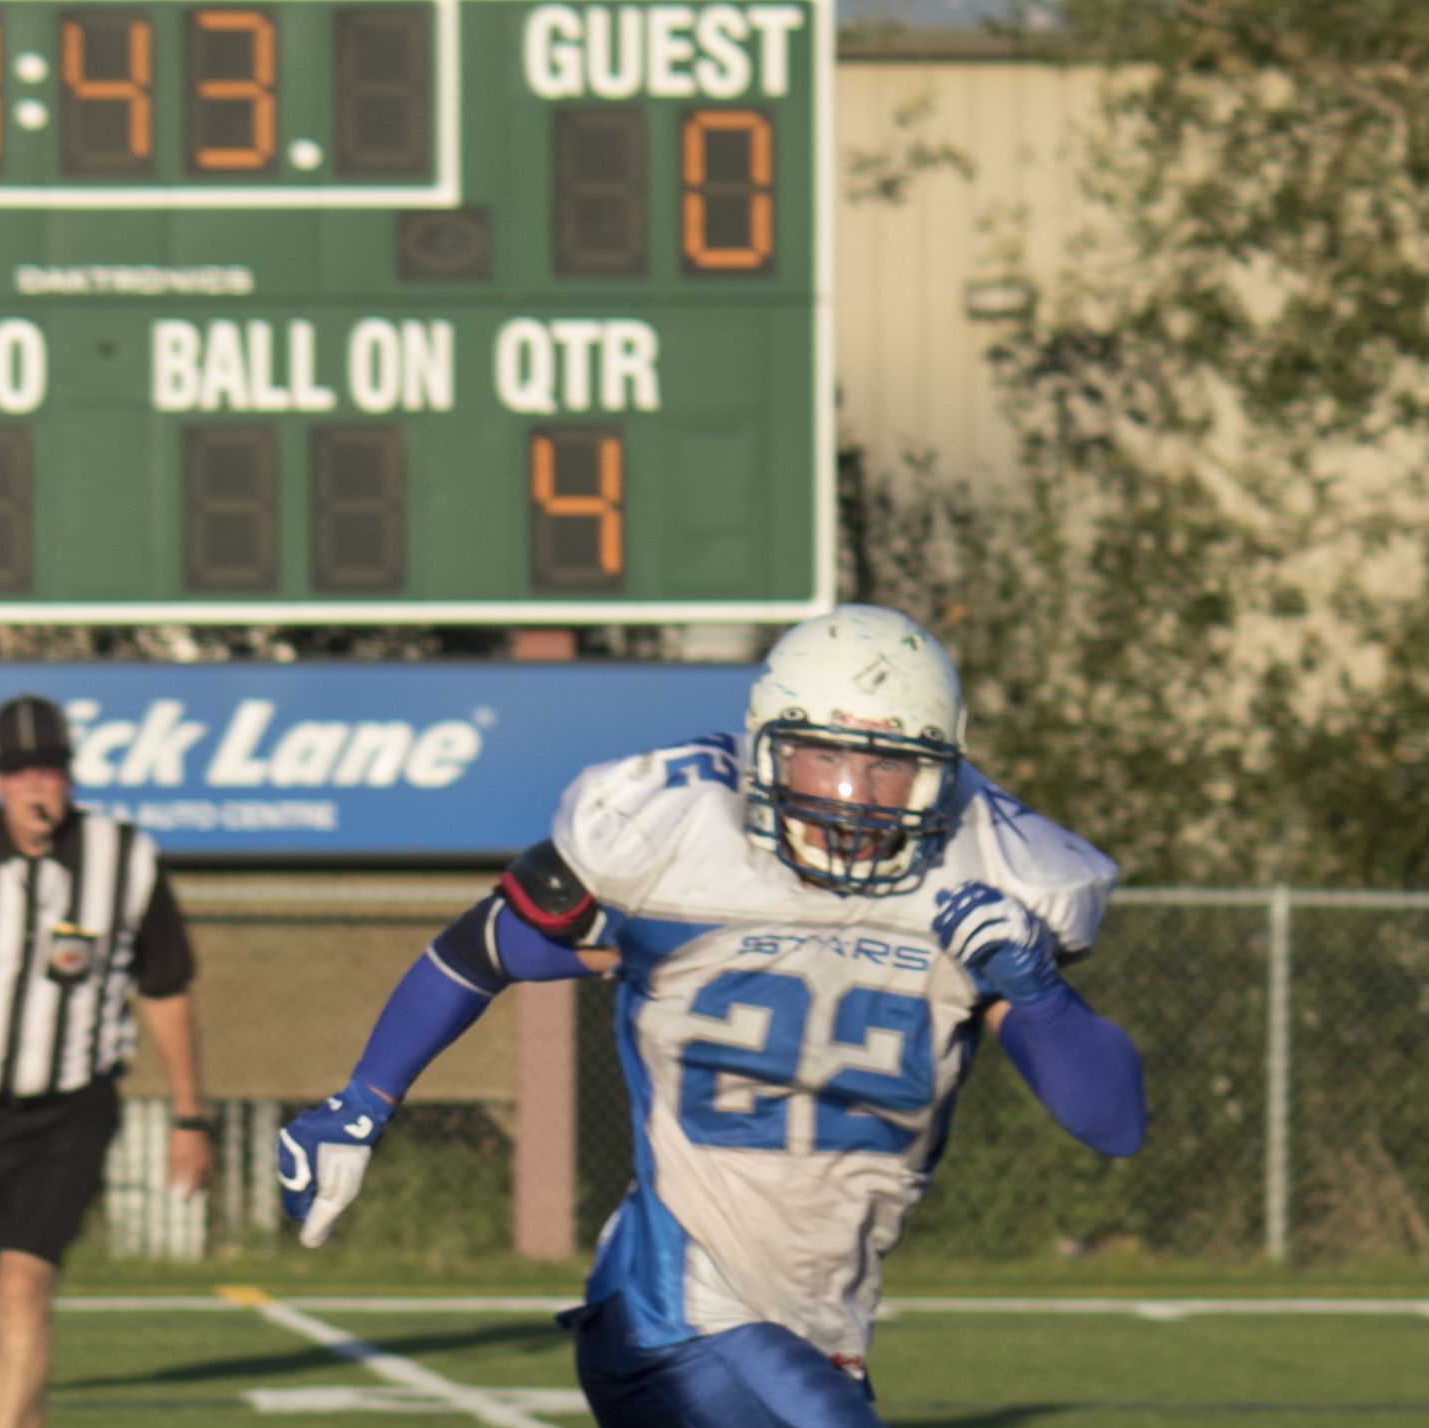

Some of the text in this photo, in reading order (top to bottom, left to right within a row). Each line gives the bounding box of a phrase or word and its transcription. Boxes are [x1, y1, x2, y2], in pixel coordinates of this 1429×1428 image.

[523, 6, 804, 99] GUEST
[683, 111, 772, 268] 0
[153, 318, 455, 414] BALL ON
[493, 318, 661, 415] QTR
[532, 437, 623, 574] 4
[205, 699, 482, 788] Lane
[738, 934, 932, 972] STARS
[676, 967, 938, 1156] 22
